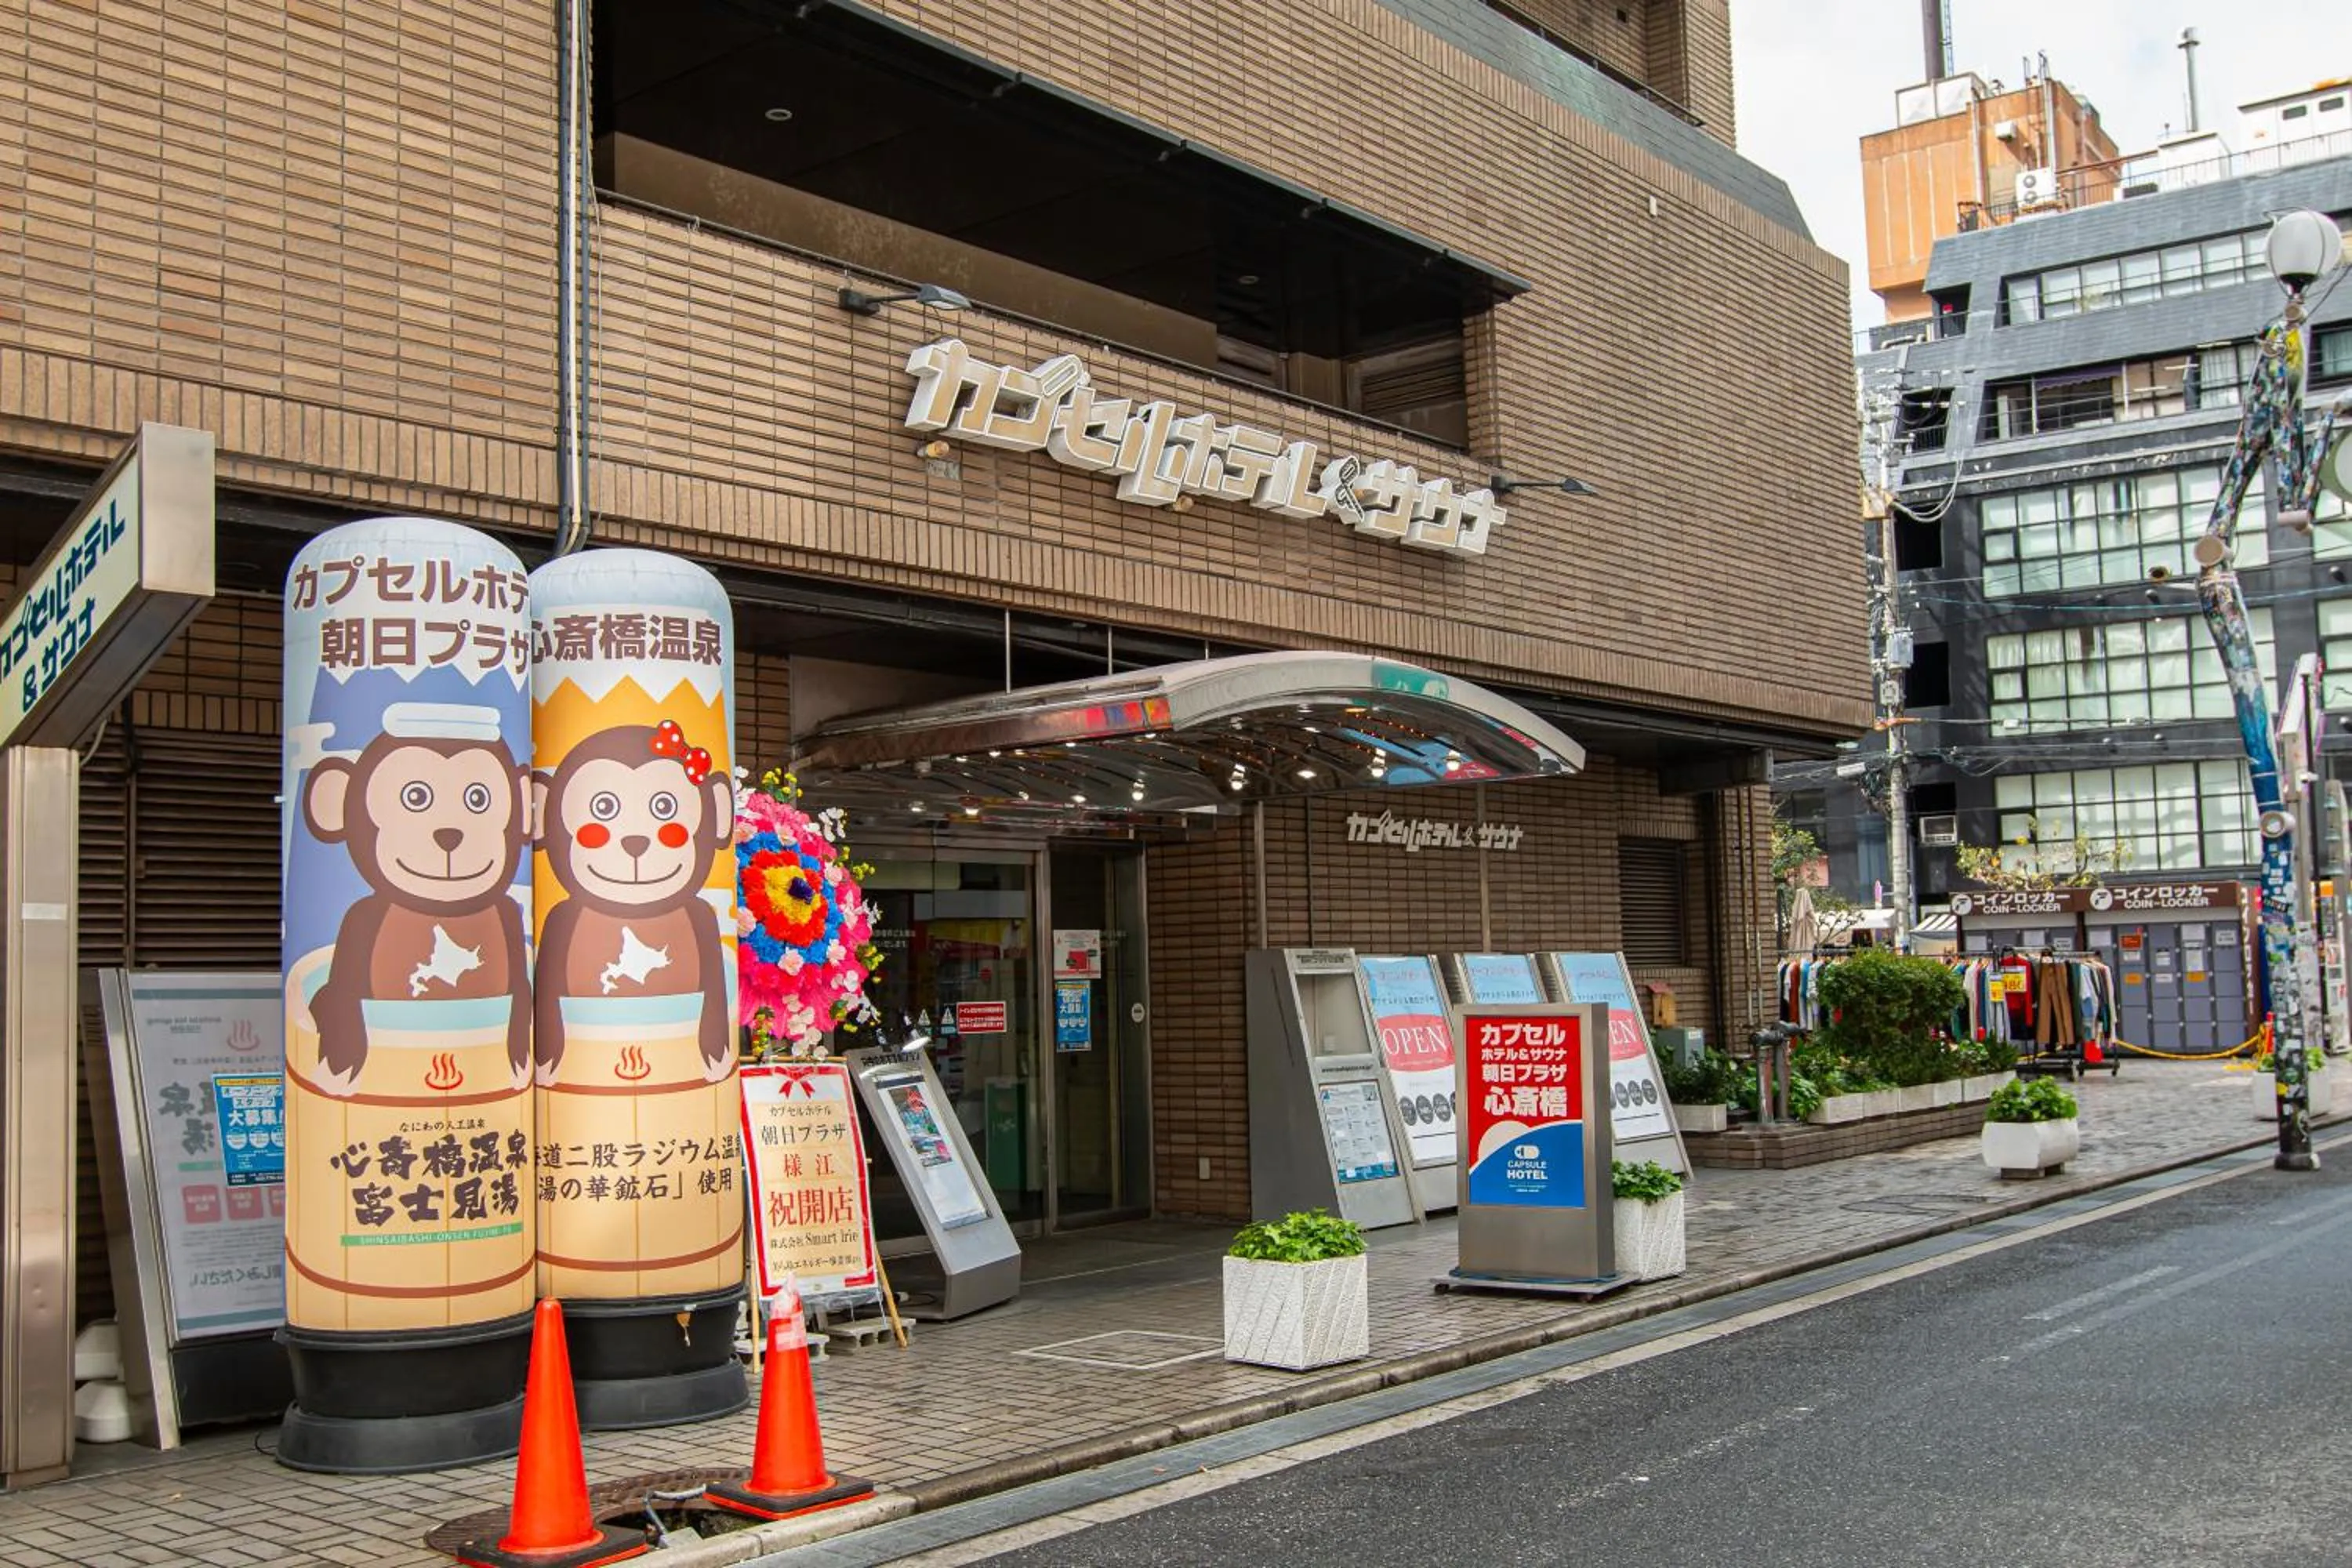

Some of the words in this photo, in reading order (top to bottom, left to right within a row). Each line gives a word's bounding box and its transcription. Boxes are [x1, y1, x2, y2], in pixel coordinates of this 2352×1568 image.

[1973, 892, 2071, 906] コインロッカー
[2114, 885, 2219, 900] コインロッカー
[1983, 902, 2061, 914] COIN-LOCKER
[2124, 897, 2210, 909] COIN-LOCKER
[1480, 1023, 1566, 1046] カプセル
[1609, 1016, 1637, 1045] EN
[1382, 1025, 1448, 1054] OPEN
[1481, 1047, 1567, 1061] ホテル&サウナ
[1482, 1063, 1568, 1083] 朝日プラザ
[1483, 1085, 1568, 1117] 心斎橋
[399, 1119, 486, 1133] なにわの人工温泉
[329, 1129, 528, 1180] 心斎橋温泉
[1507, 1160, 1547, 1169] CAPSULE
[1506, 1169, 1548, 1180] HOTEL
[352, 1172, 520, 1228] 富士見湯
[768, 1185, 854, 1228] 祝開店
